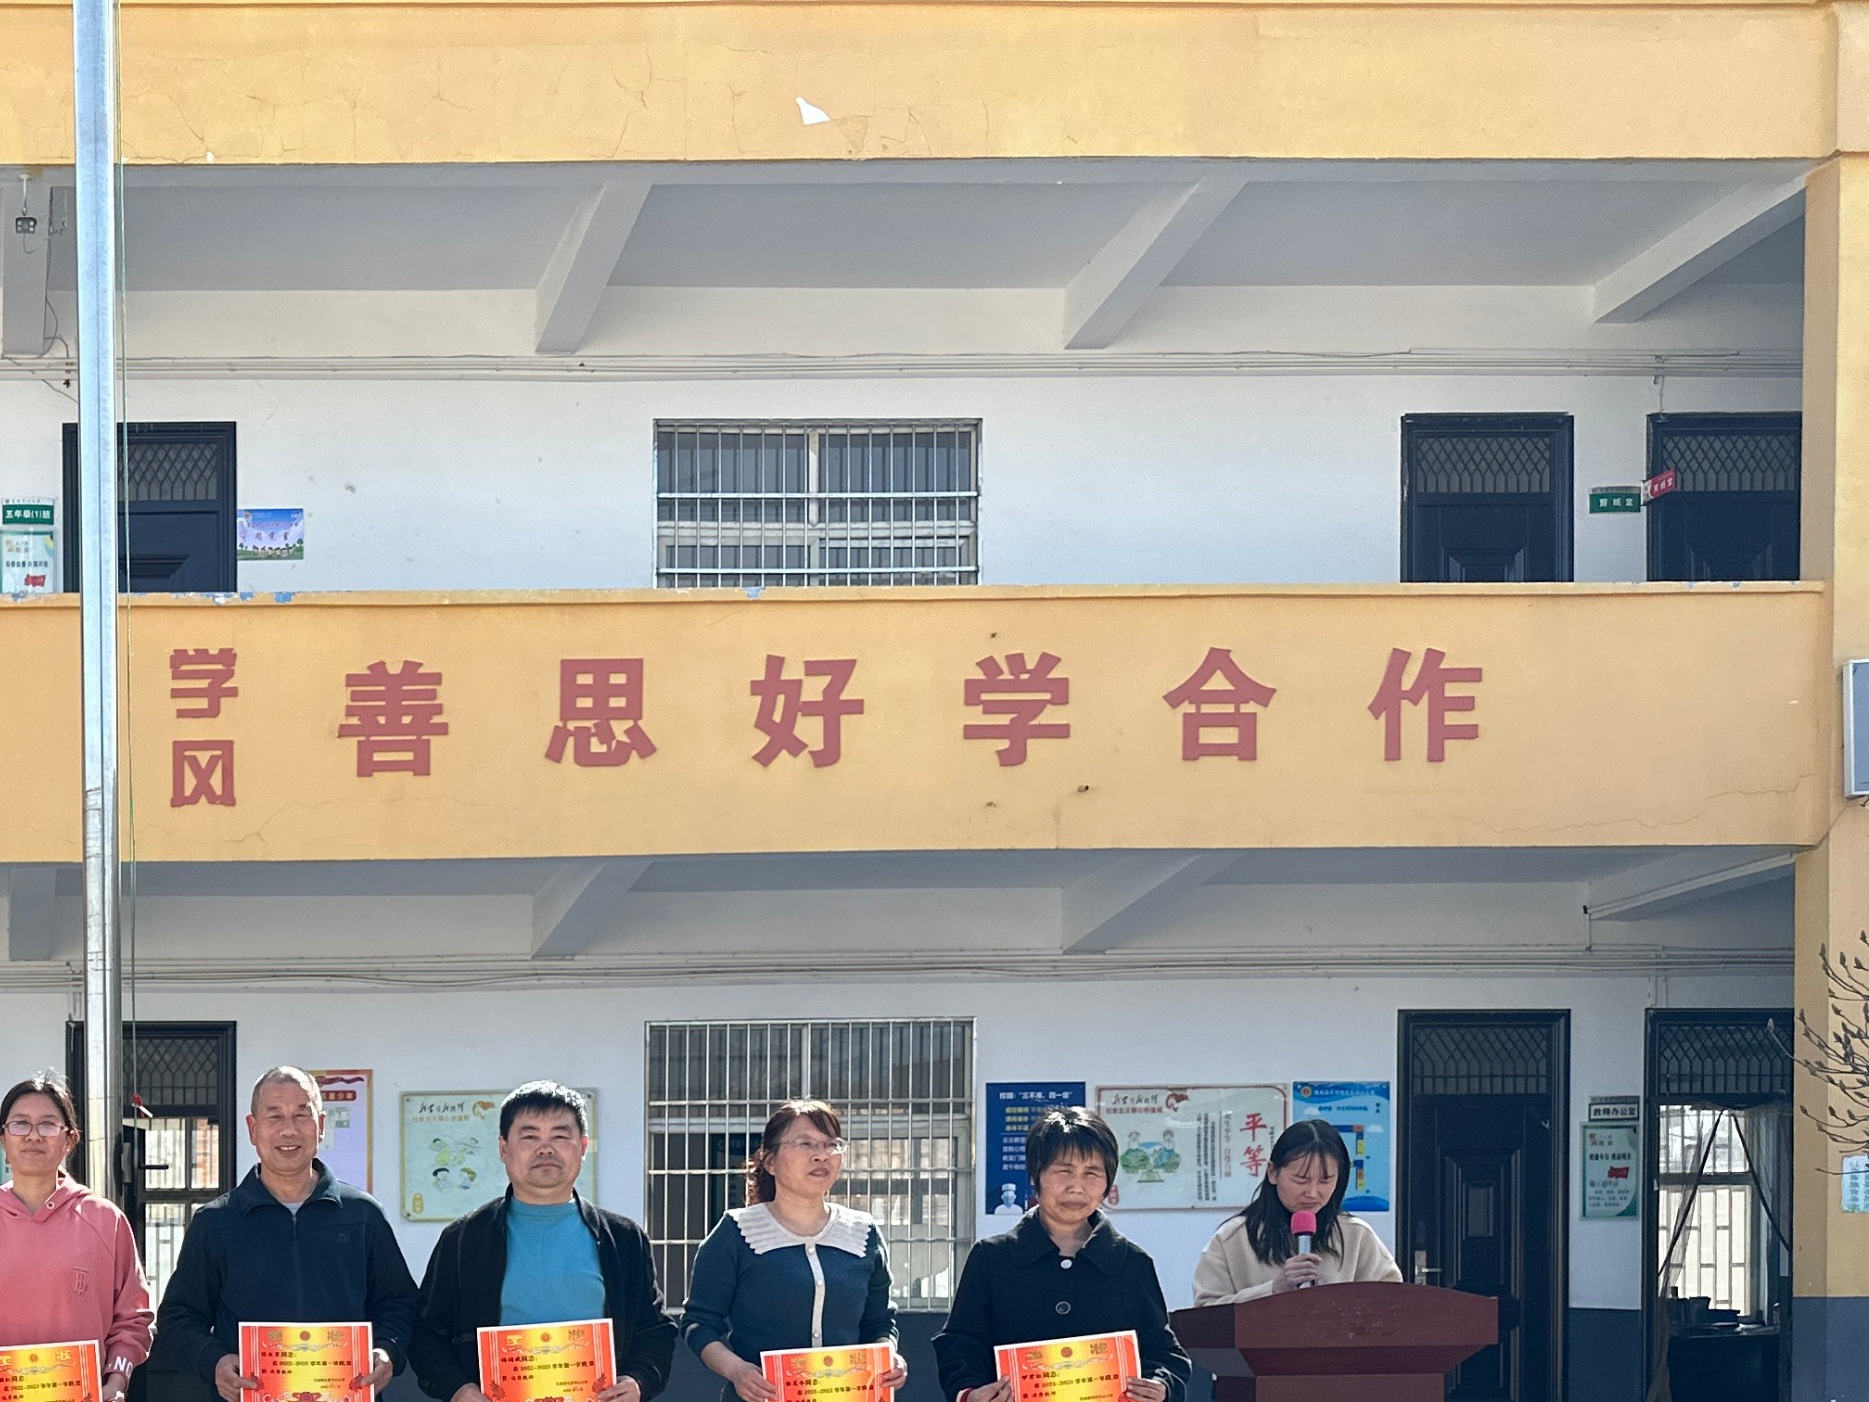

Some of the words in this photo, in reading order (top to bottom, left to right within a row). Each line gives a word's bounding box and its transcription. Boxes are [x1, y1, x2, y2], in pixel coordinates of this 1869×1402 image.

[5, 510, 51, 519] 五年级(1)班
[170, 648, 238, 808] 学风
[338, 647, 1483, 778] 善思好学合作
[1240, 1112, 1268, 1177] 平等
[1594, 1108, 1636, 1116] 教师办公室
